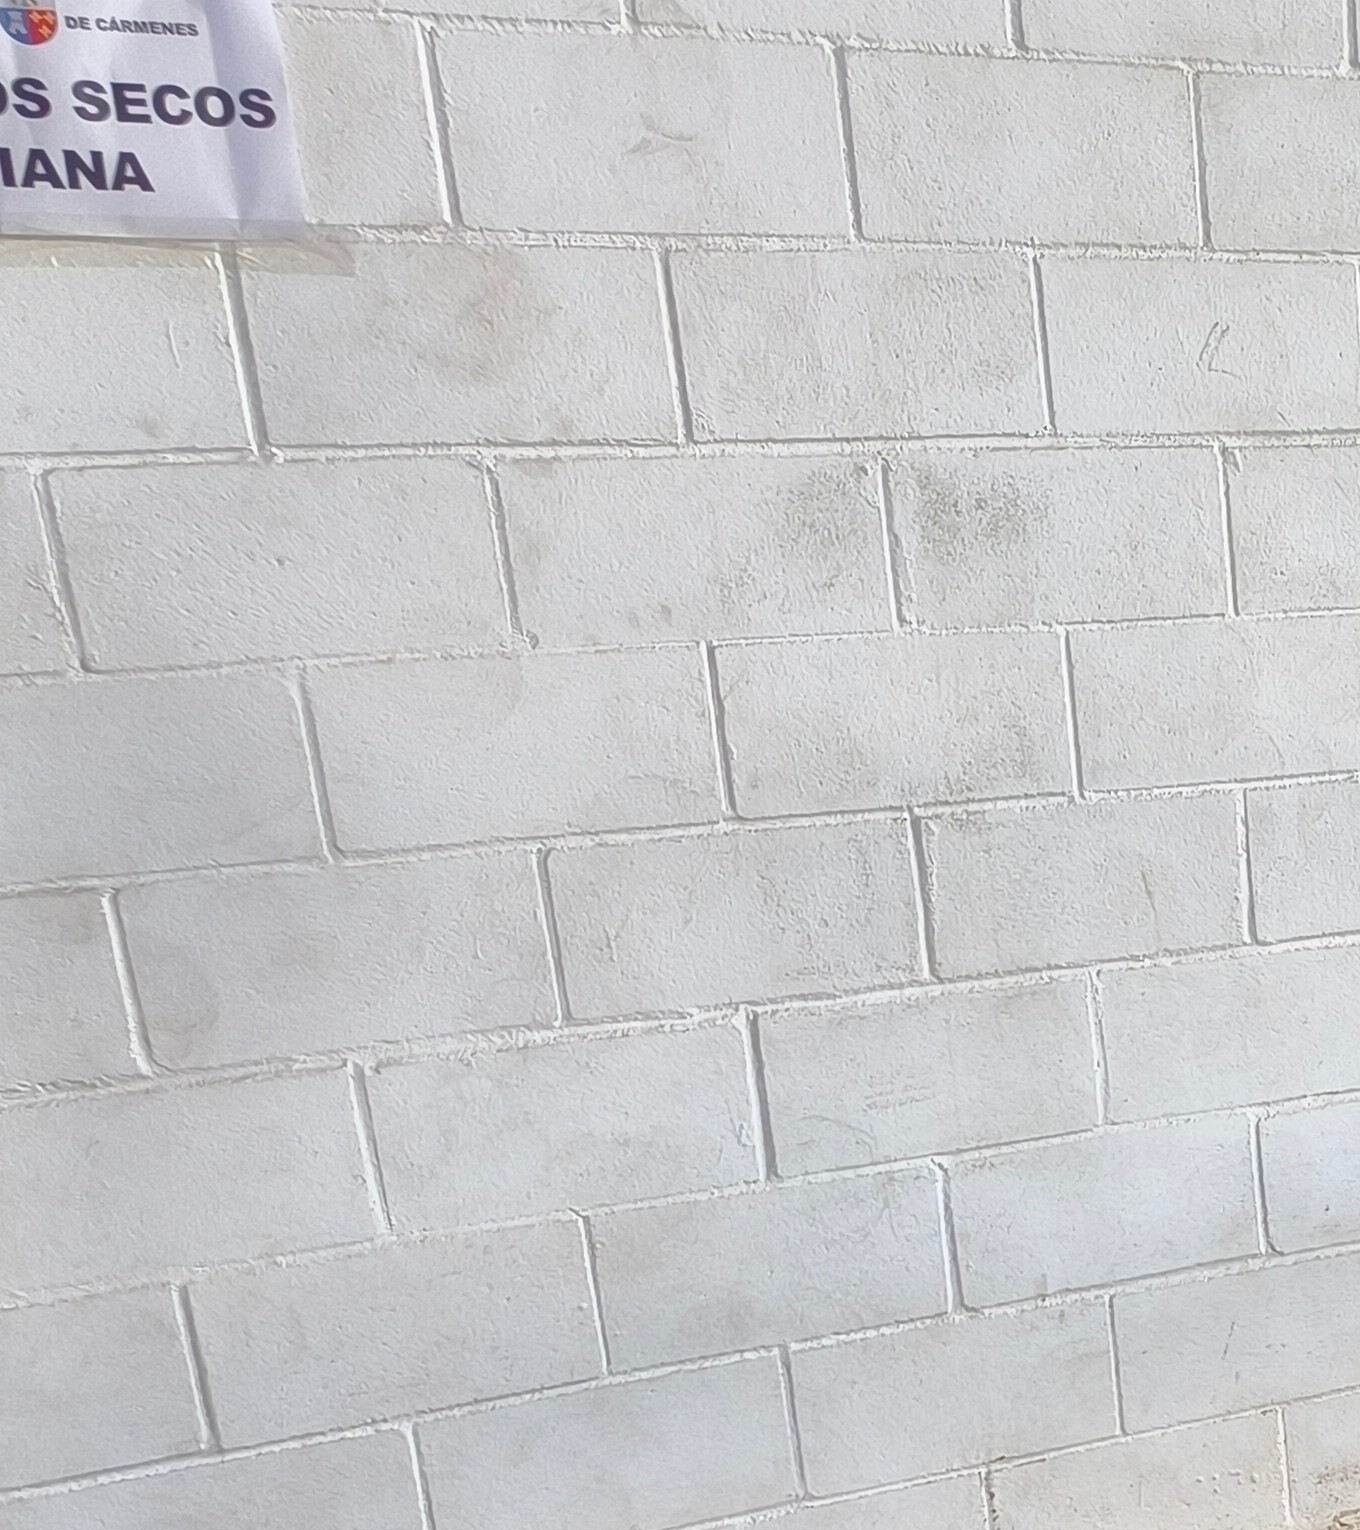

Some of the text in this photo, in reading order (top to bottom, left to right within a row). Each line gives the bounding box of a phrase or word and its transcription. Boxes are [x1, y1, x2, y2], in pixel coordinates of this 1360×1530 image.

[64, 15, 199, 37] DE CÁRMENES
[71, 80, 277, 129] SECOS
